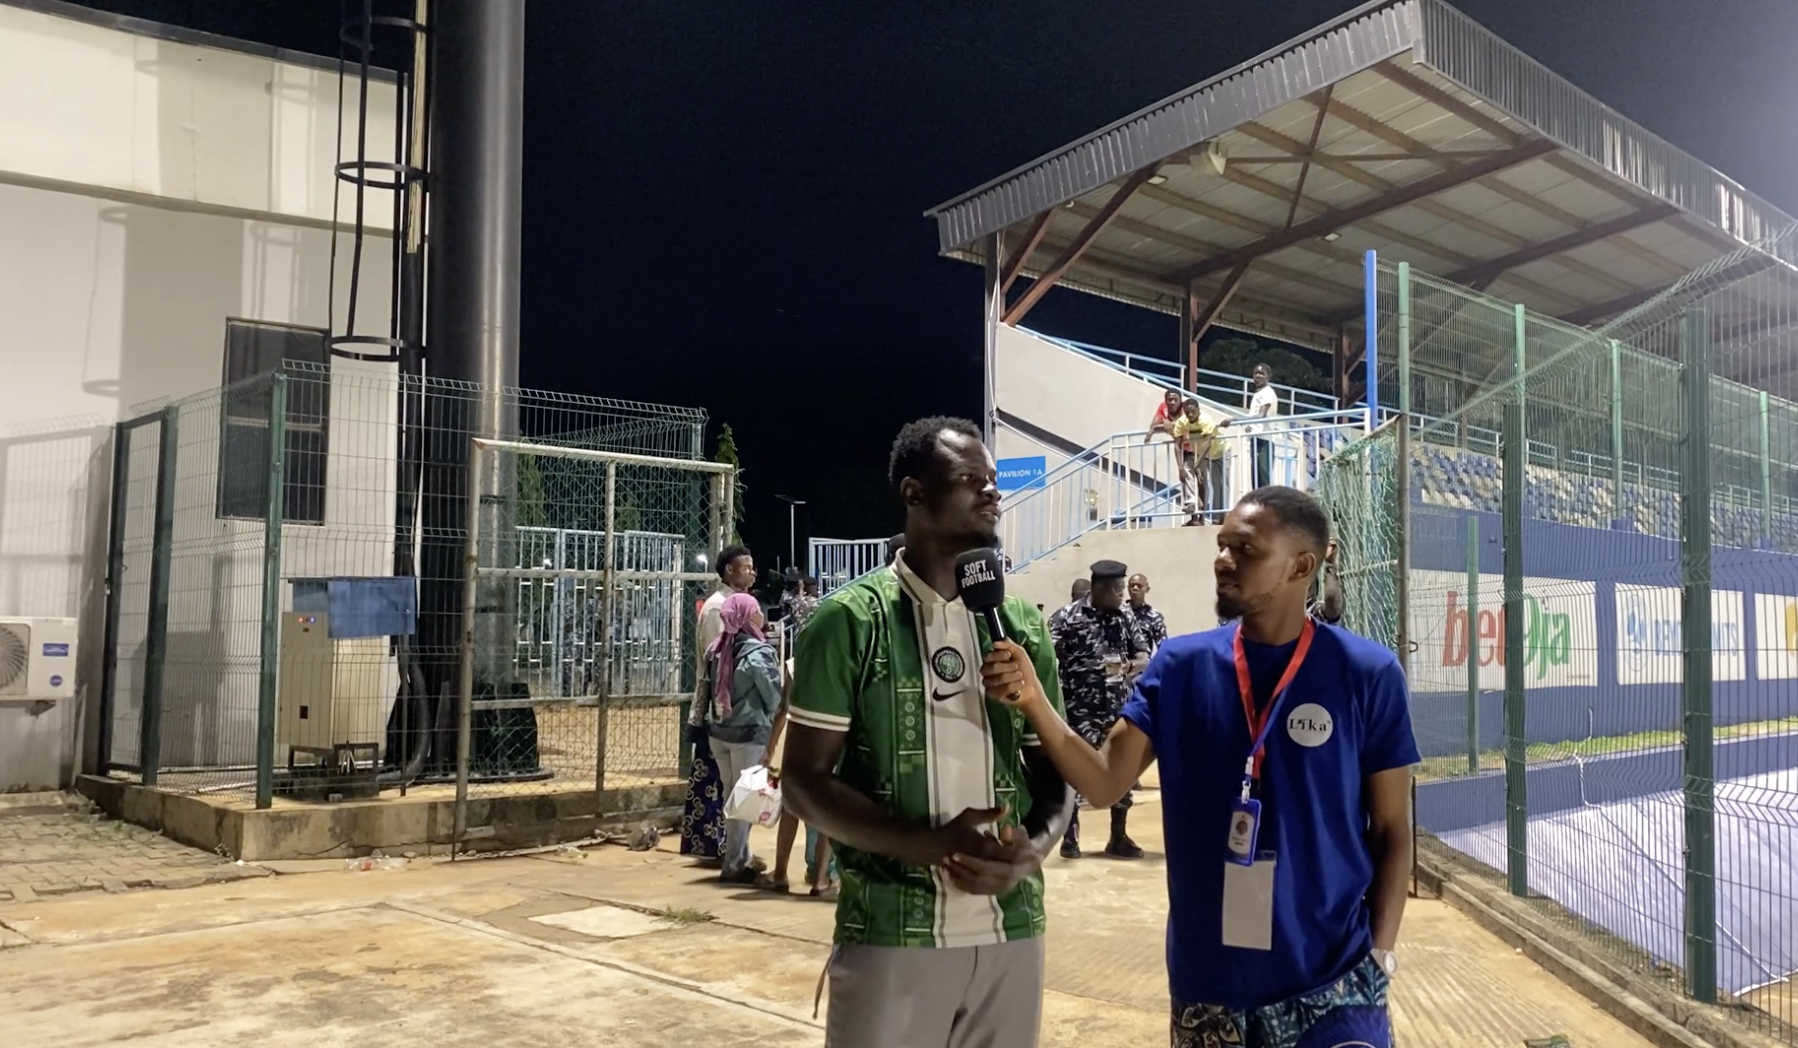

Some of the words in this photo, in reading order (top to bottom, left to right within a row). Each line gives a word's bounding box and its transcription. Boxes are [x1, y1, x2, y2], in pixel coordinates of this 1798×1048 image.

[998, 469, 1031, 479] PAVILION
[1033, 468, 1043, 476] 1A
[964, 560, 986, 577] SOFT
[961, 570, 996, 588] FOOTBALL
